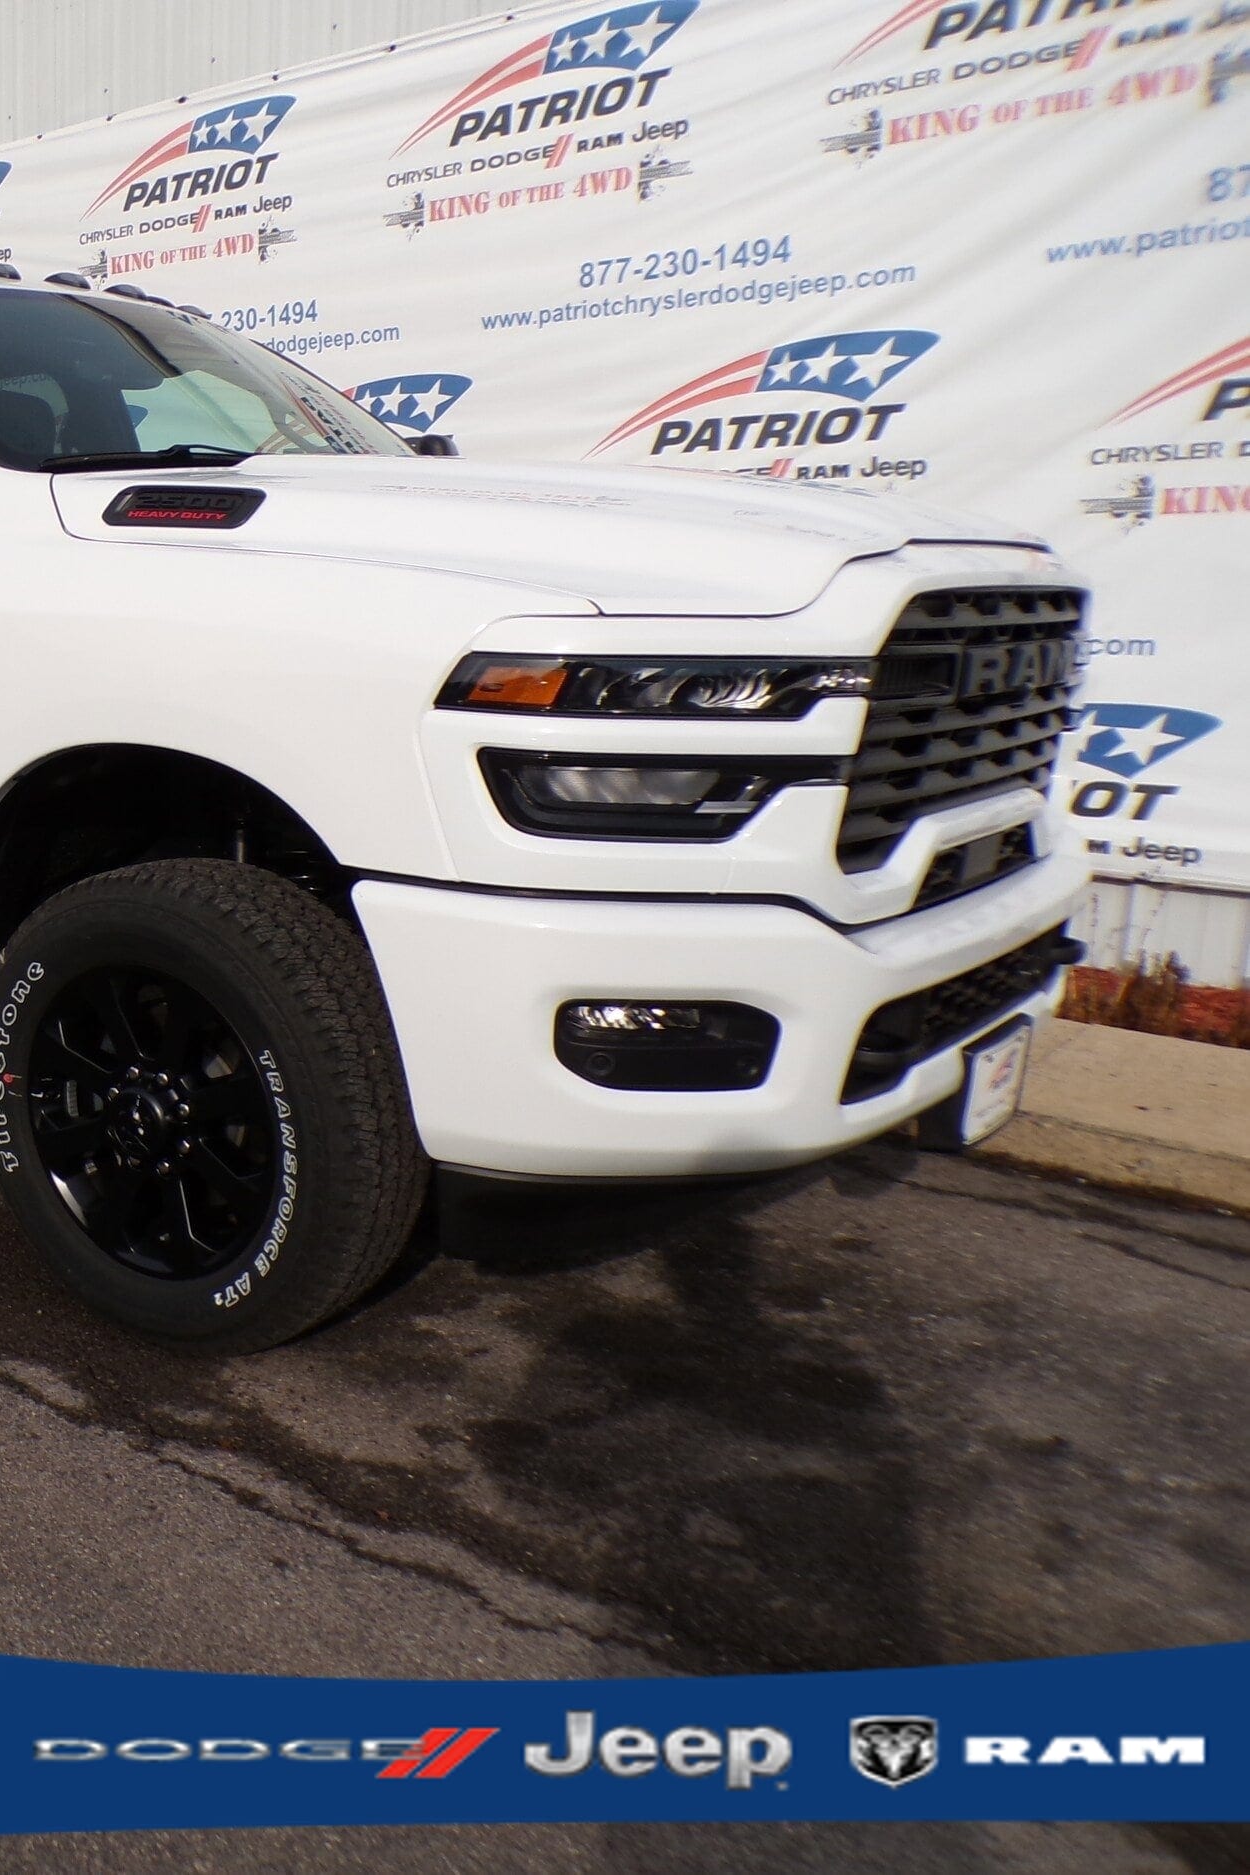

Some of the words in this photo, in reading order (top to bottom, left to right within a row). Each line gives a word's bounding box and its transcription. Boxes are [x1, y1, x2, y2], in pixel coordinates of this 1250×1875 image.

[827, 68, 940, 105] CHRYSLER
[953, 39, 1085, 80] DODGE
[449, 67, 673, 148] PATRIOT
[888, 104, 981, 146] KING
[992, 100, 1028, 124] OF
[1036, 87, 1095, 116] THE
[1108, 63, 1199, 105] 4WD
[386, 162, 462, 188] CHRYSLER
[470, 143, 555, 173] DODGE
[576, 132, 623, 153] RAM
[632, 118, 689, 143] Jeep
[123, 152, 280, 212] PATRIOT
[429, 191, 491, 222] KING
[499, 190, 517, 209] OF
[526, 181, 565, 204] THE
[573, 166, 634, 198] 4WD
[79, 225, 134, 246] CHRYSLER
[139, 212, 200, 234] DODGE
[214, 204, 248, 221] RAM
[253, 194, 293, 215] Jeep
[110, 251, 155, 275] KING
[160, 249, 176, 265] OF
[179, 244, 207, 262] THE
[213, 233, 255, 257] 4WD
[579, 235, 792, 289] 877-230-1494
[207, 299, 319, 332] 230-1494
[481, 264, 917, 330] www.patriotchryslerdodgejeep.com
[262, 324, 401, 356] dodgejeep.com
[650, 402, 907, 456] PATRIOT
[1090, 441, 1224, 466] CHRYSLER
[796, 463, 851, 481] RAM
[860, 456, 928, 480] Jeep
[127, 510, 179, 519] HEAVY
[180, 511, 228, 521] DUTY
[1070, 780, 1182, 821] OT
[1119, 836, 1202, 868] Jeep
[254, 1049, 298, 1277] TRANSFORCE
